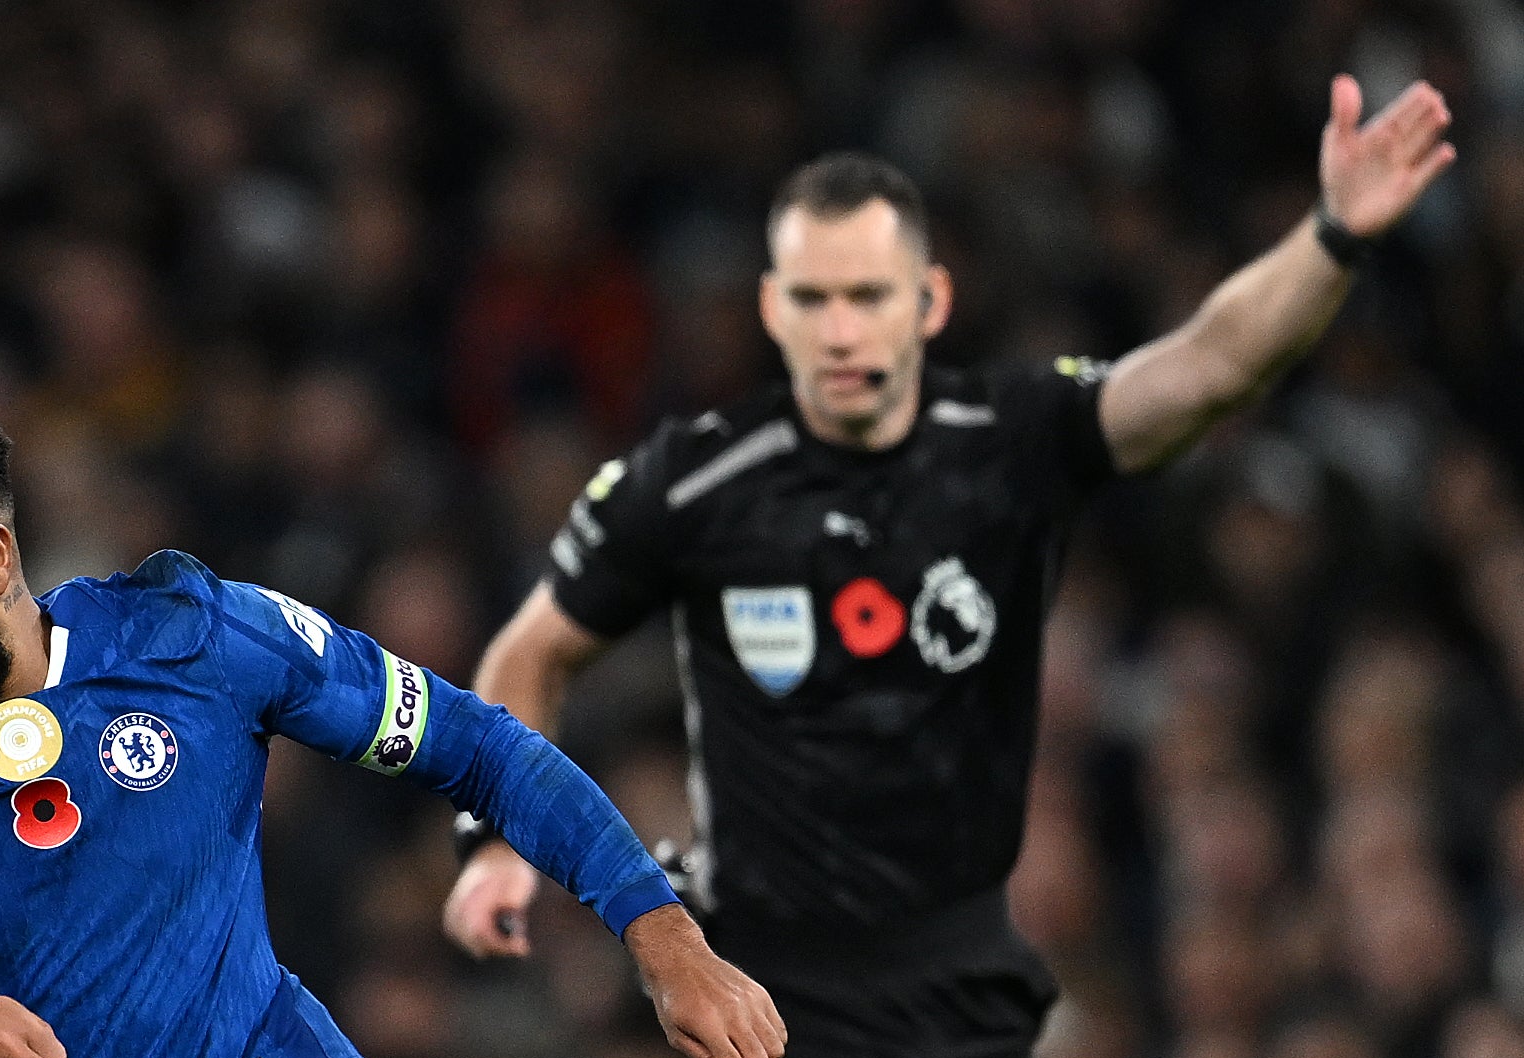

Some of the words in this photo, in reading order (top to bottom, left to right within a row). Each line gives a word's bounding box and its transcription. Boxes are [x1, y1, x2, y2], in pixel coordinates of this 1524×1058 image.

[395, 658, 421, 730] Capta
[105, 716, 152, 741] CHELSEA
[16, 755, 48, 776] FIFA
[124, 778, 158, 788] FOOTBALL
[158, 764, 171, 780] CLUB
